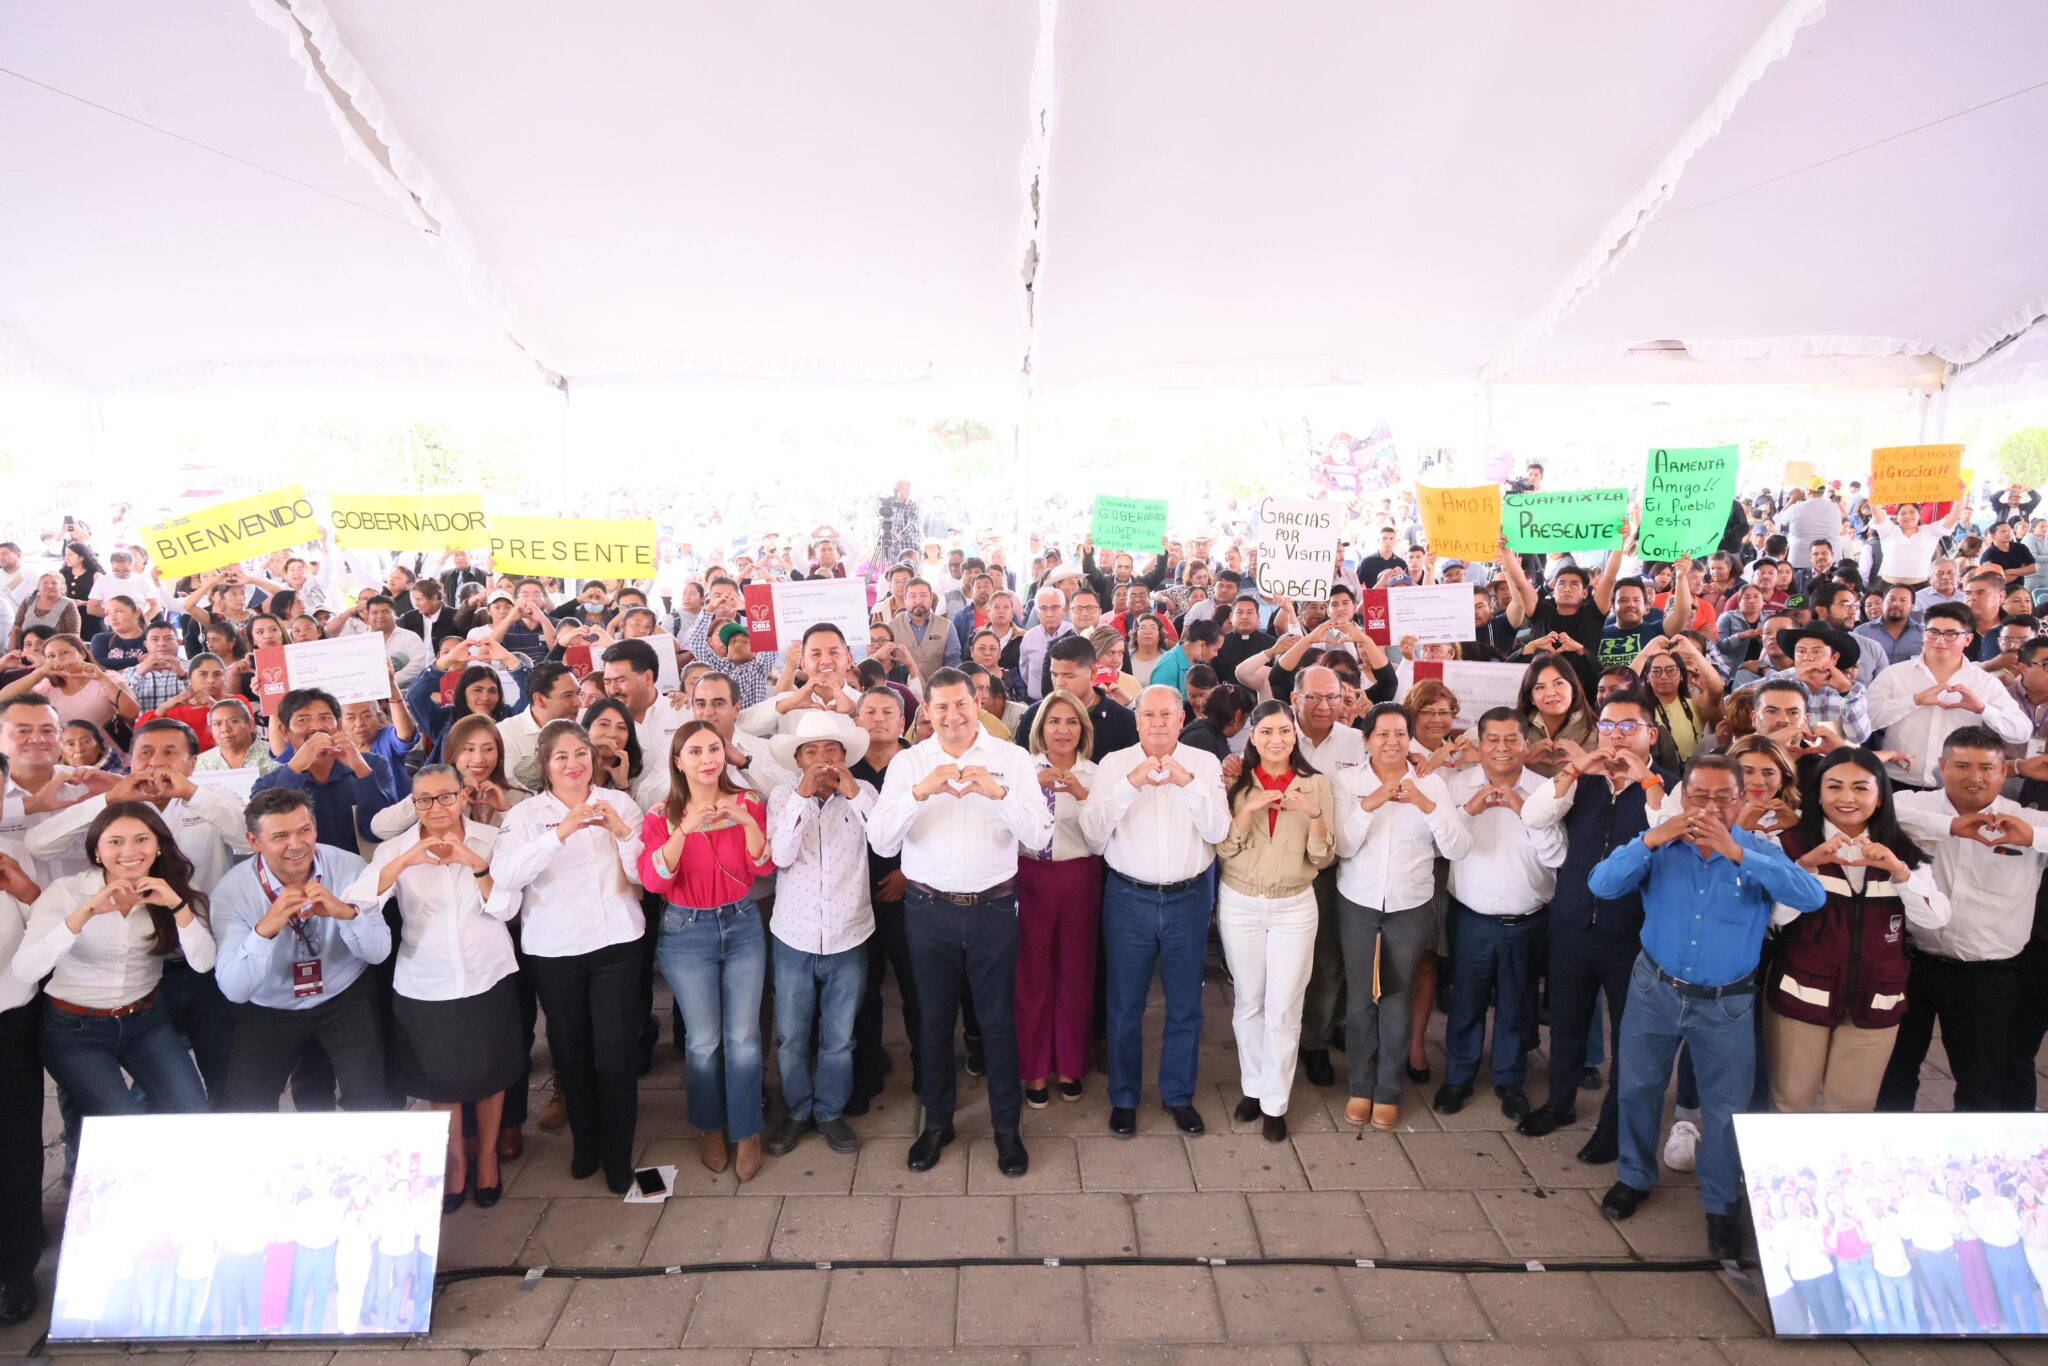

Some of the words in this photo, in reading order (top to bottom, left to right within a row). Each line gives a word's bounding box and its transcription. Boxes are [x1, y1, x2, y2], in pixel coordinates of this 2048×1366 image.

[1441, 490, 1494, 514] AMOR
[1672, 498, 1715, 513] Pueblo
[156, 499, 314, 560] BIENVENIDO
[331, 510, 487, 532] GOBERNADOR
[1655, 514, 1691, 528] esta
[1275, 528, 1300, 543] POR
[490, 538, 652, 565] PRESENTE
[1259, 562, 1327, 600] GOBER
